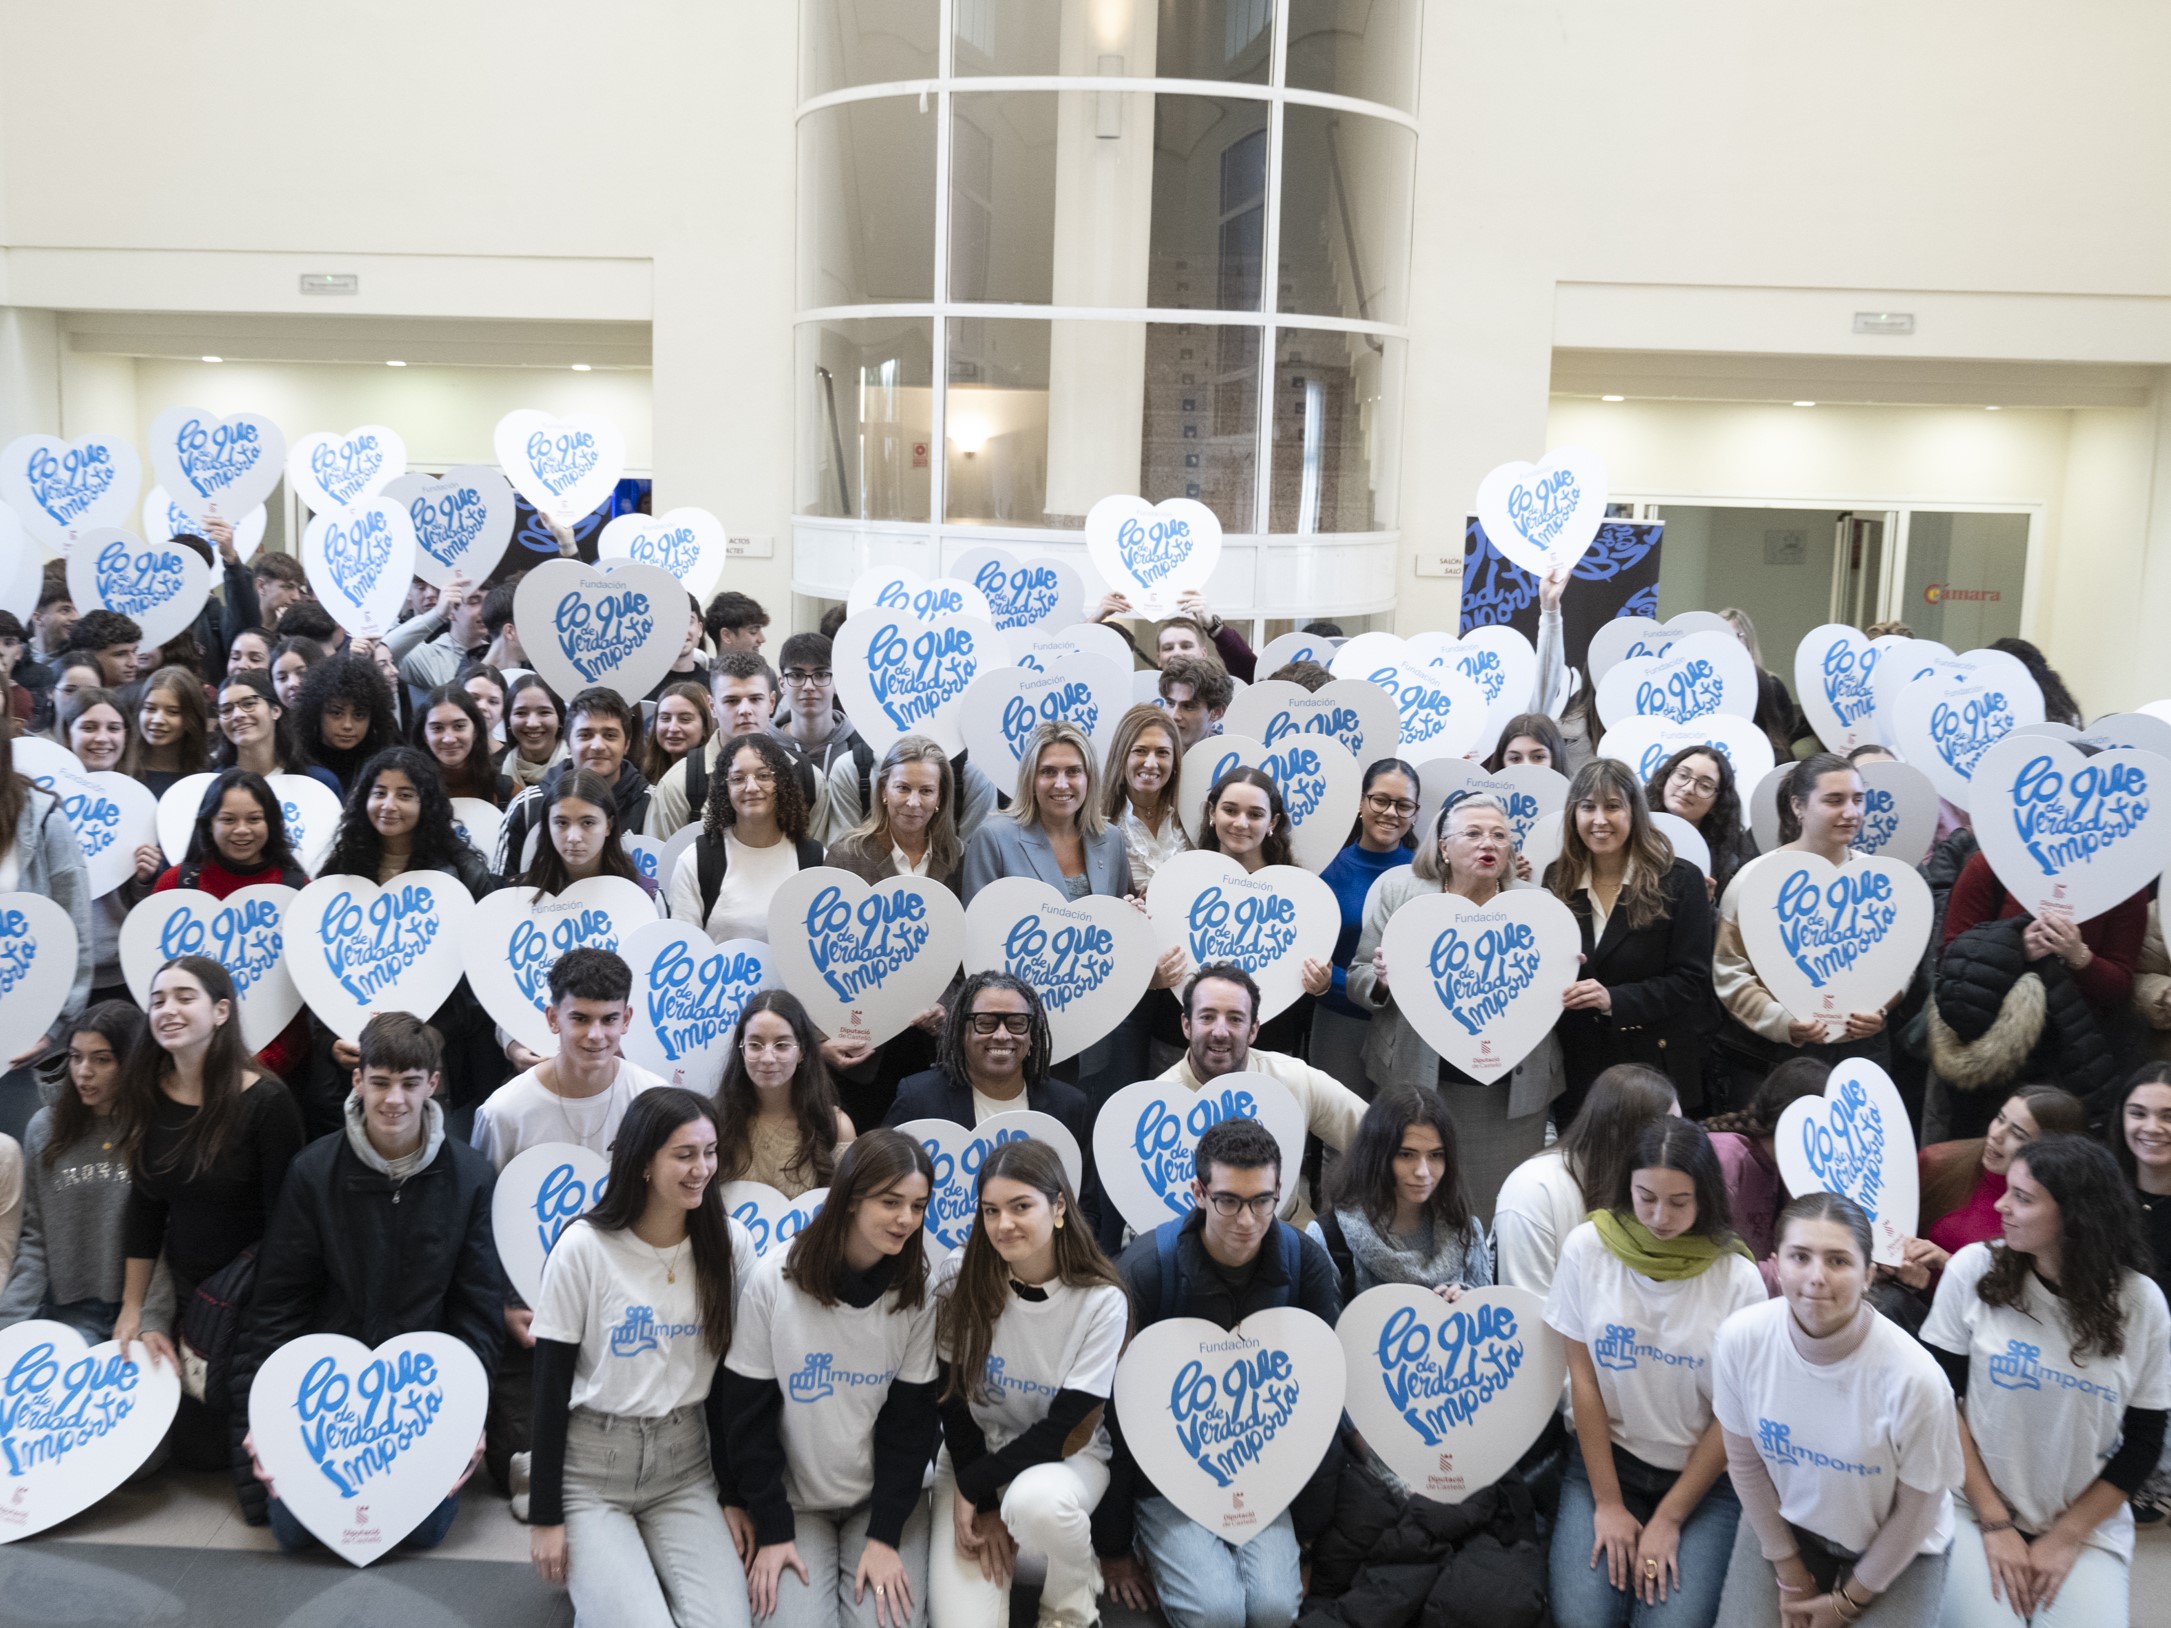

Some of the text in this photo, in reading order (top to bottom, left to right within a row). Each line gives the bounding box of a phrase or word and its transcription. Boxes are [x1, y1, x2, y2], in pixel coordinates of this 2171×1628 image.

[212, 422, 258, 463] que
[339, 435, 378, 475] que
[556, 432, 594, 466] que
[63, 444, 110, 489] que
[439, 488, 480, 532] que
[1535, 470, 1575, 516] que
[349, 511, 387, 565] que
[657, 528, 695, 566] que
[1148, 519, 1190, 557] que
[133, 552, 183, 589] que
[580, 579, 627, 590] Fundación
[1010, 567, 1057, 607] que
[595, 591, 650, 641] que
[913, 588, 963, 620] que
[989, 590, 1035, 617] erdad
[913, 627, 974, 683] que
[1033, 641, 1075, 650] Fundación
[1019, 674, 1066, 691] Fundación
[1401, 661, 1441, 686] Fundación
[1668, 659, 1713, 714] que
[1040, 682, 1092, 722] que
[1289, 698, 1336, 708] Fundación
[1398, 686, 1452, 717] que
[1962, 692, 2008, 743] que
[1466, 777, 1515, 790] Fundación
[2070, 763, 2147, 822] que
[1222, 873, 1274, 892] Fundación
[1826, 870, 1892, 933] que
[369, 885, 434, 950] que
[530, 900, 584, 915] Fundación
[857, 889, 926, 950] que
[1041, 902, 1093, 922] Fundación
[1234, 895, 1295, 946] que
[1454, 912, 1508, 924] Fundación
[211, 898, 280, 965] que
[552, 909, 612, 954] que
[1051, 925, 1114, 975] que
[1474, 922, 1535, 984] que
[696, 952, 762, 1008] que
[840, 1027, 871, 1035] Diputació
[1186, 1089, 1257, 1139] que
[1829, 1079, 1867, 1162] que
[1198, 1336, 1261, 1353] Fundación
[1438, 1303, 1518, 1380] que
[54, 1355, 139, 1417] que
[357, 1350, 438, 1430] que
[1222, 1348, 1292, 1424] que
